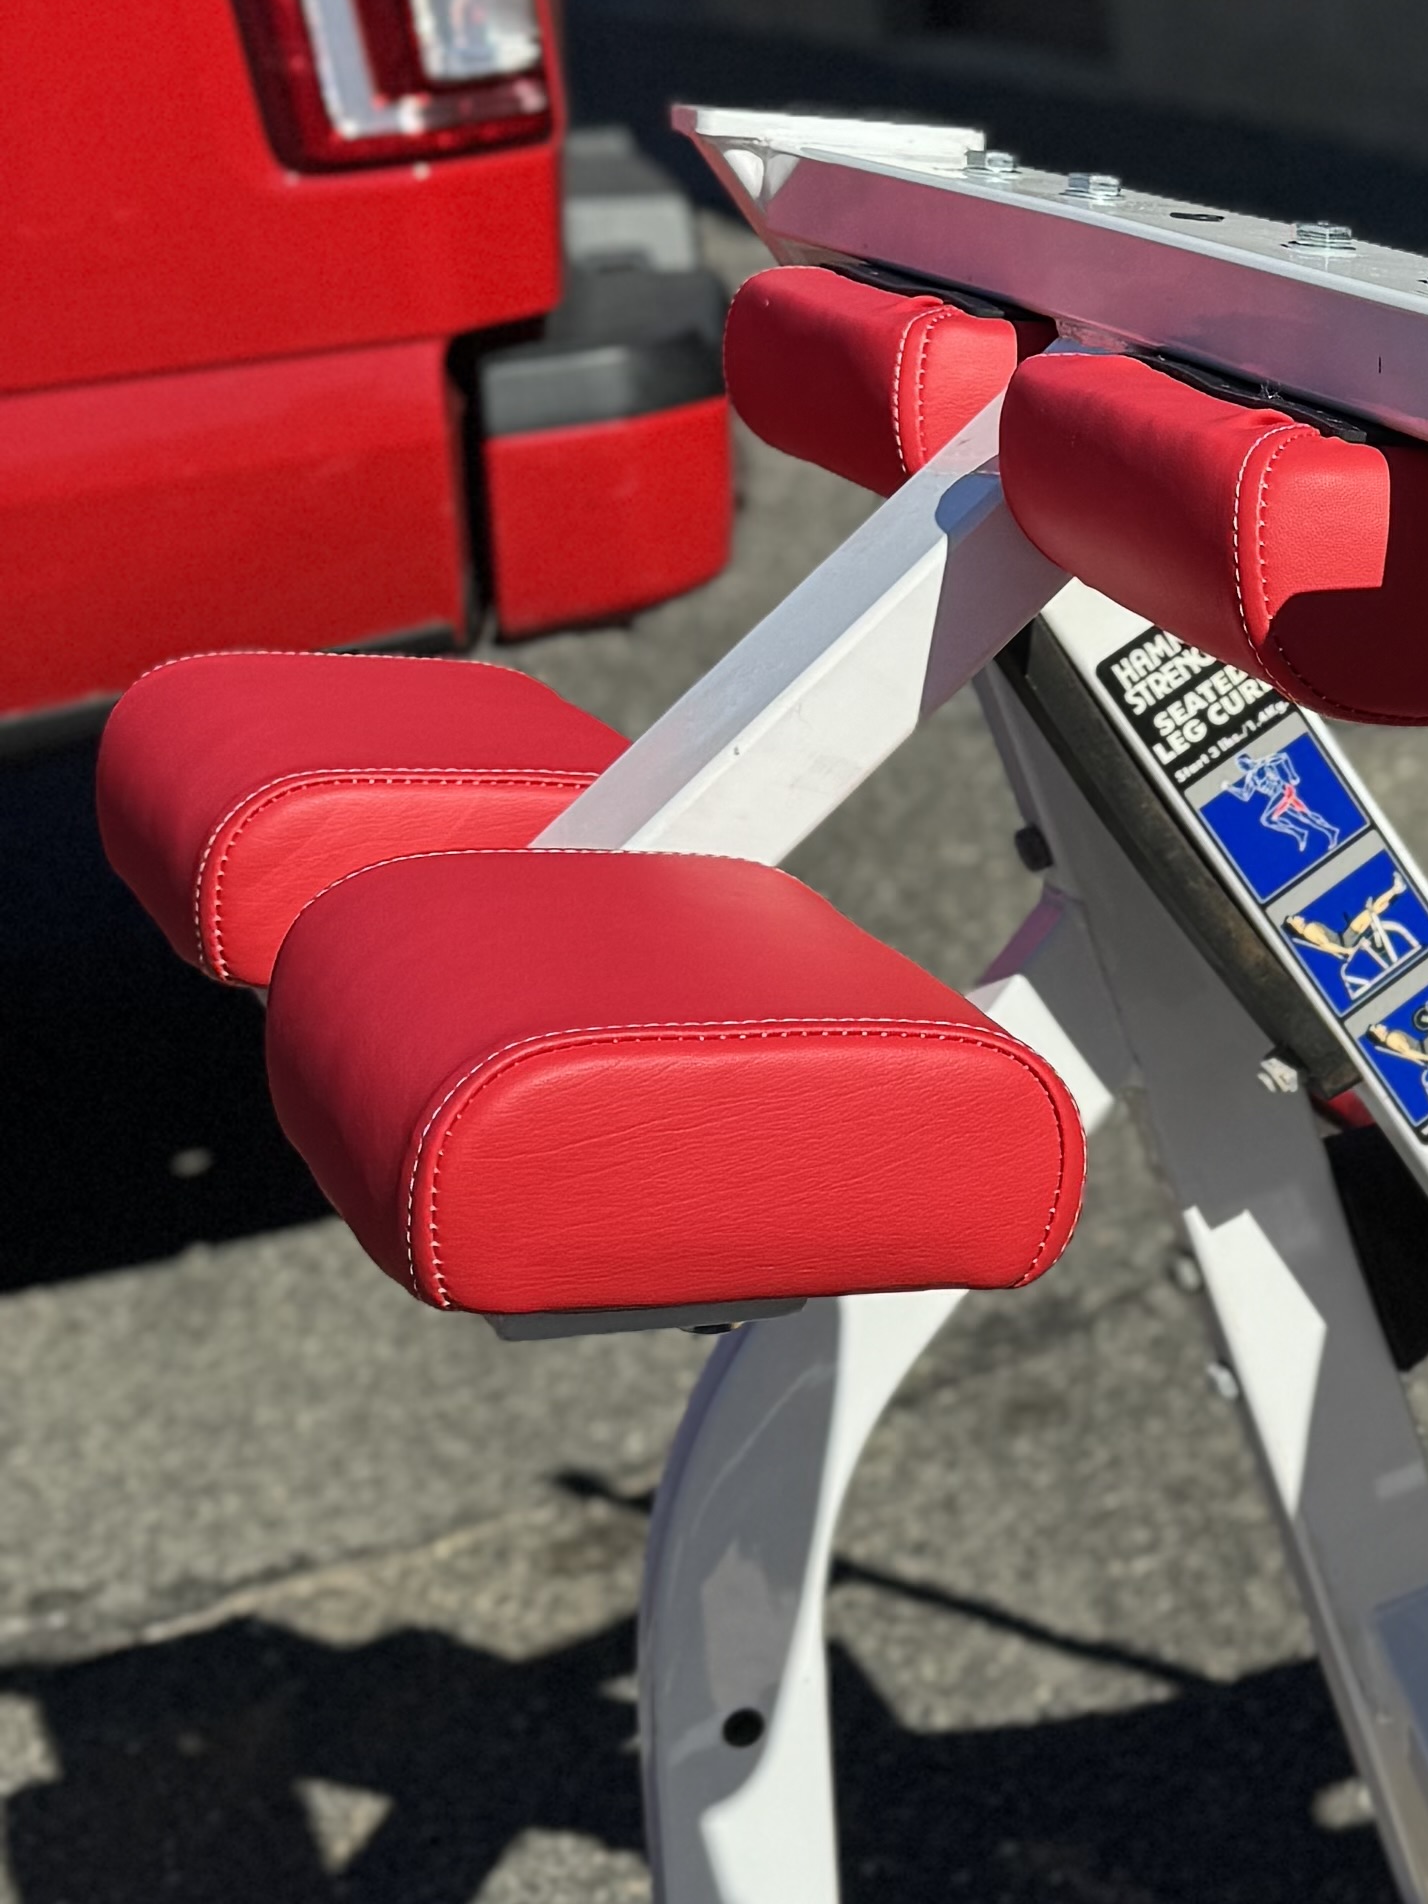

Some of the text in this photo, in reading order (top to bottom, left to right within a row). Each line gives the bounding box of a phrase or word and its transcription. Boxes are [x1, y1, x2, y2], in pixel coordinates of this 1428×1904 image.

[1110, 630, 1185, 690] HAM
[1124, 646, 1217, 716] STRENG
[1152, 718, 1208, 765] LEG
[1174, 748, 1210, 783] Start
[1208, 746, 1221, 760] 3
